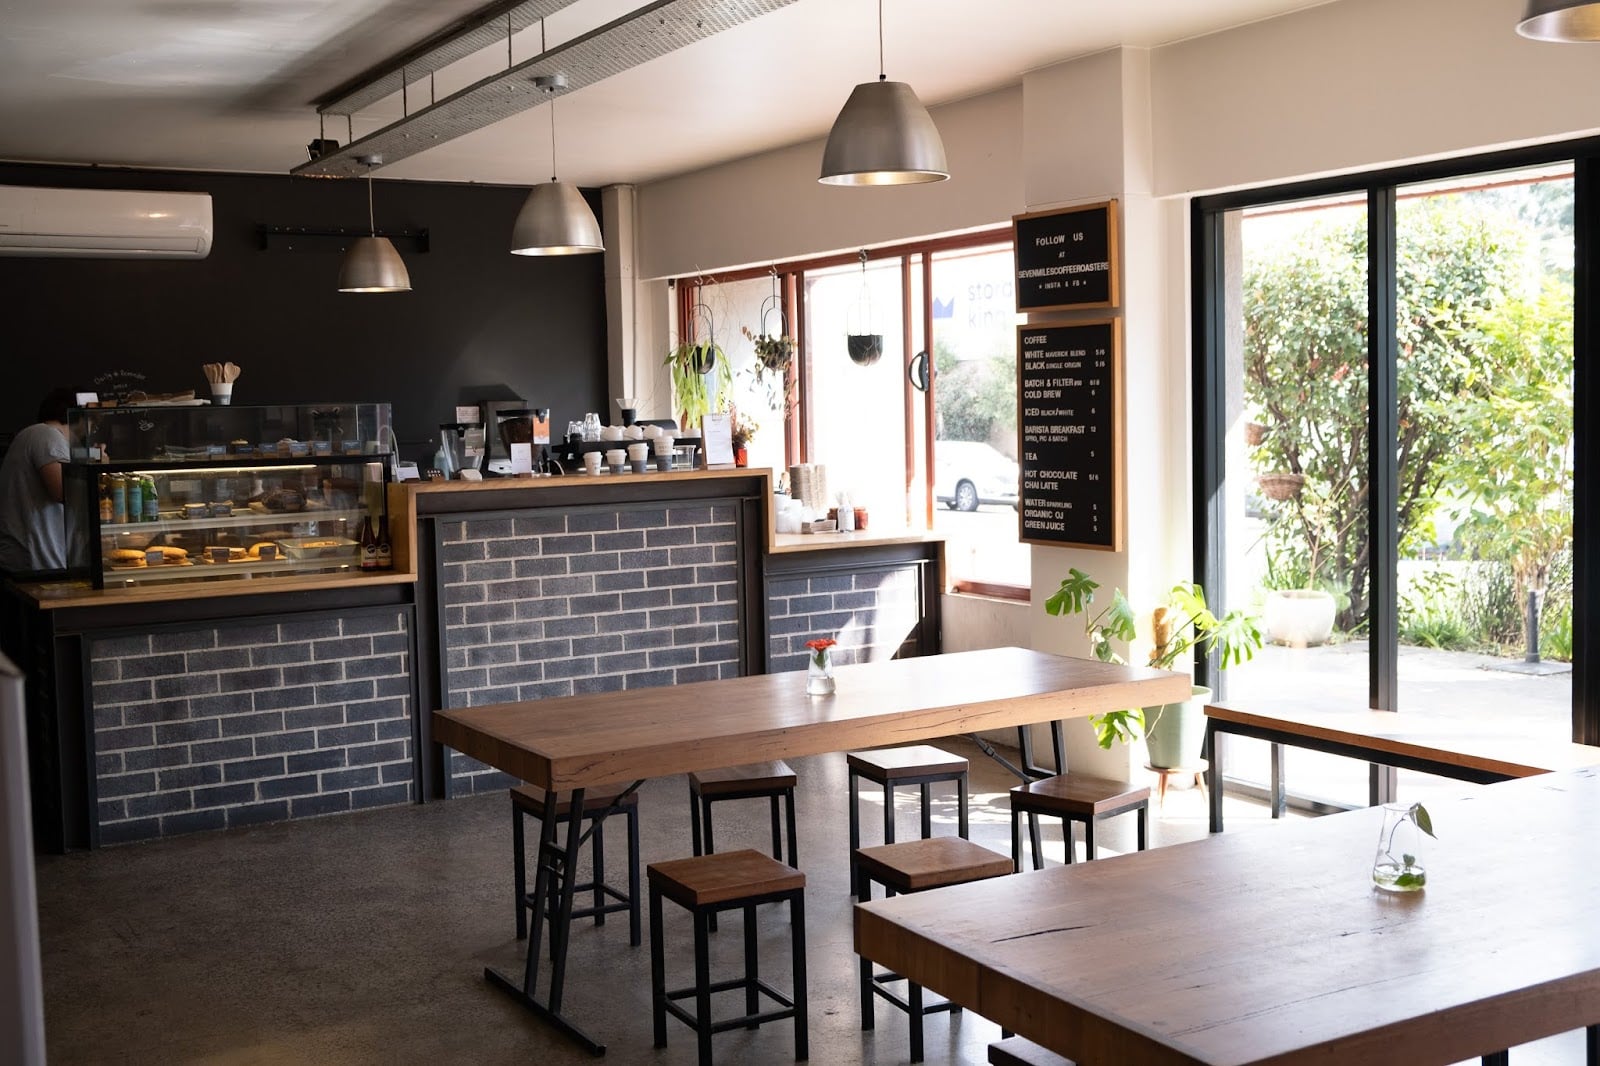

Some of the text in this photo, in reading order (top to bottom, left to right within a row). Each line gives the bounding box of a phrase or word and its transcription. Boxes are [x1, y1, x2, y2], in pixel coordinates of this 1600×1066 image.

[1036, 232, 1084, 246] FOLLOW US
[1018, 262, 1110, 279] SEVENMILESCOFFEEROASTERS
[1044, 281, 1061, 289] INSTA
[1072, 279, 1080, 287] FB
[1024, 336, 1047, 344] COFFEE
[1025, 350, 1044, 359] WHITE
[1045, 350, 1069, 358] MAVERICK
[1025, 362, 1045, 370] BLACK
[1025, 379, 1044, 387] BATCH
[1046, 379, 1051, 387] &
[1053, 378, 1074, 387] FILTER
[1025, 391, 1042, 399] COLD
[1043, 390, 1062, 398] BREW
[1025, 408, 1040, 416] ICED
[1025, 426, 1049, 434] BARISTA
[1050, 426, 1085, 434] BREAKFAST
[1025, 452, 1038, 460] TEA
[1025, 470, 1037, 478] HOT
[1040, 471, 1078, 480] CHOCOLATE
[1040, 482, 1058, 490] LATTE
[1025, 510, 1053, 519] ORGANIC
[1055, 512, 1064, 520] OJ
[1025, 520, 1046, 529] GREEN
[1046, 522, 1065, 531] JUICE
